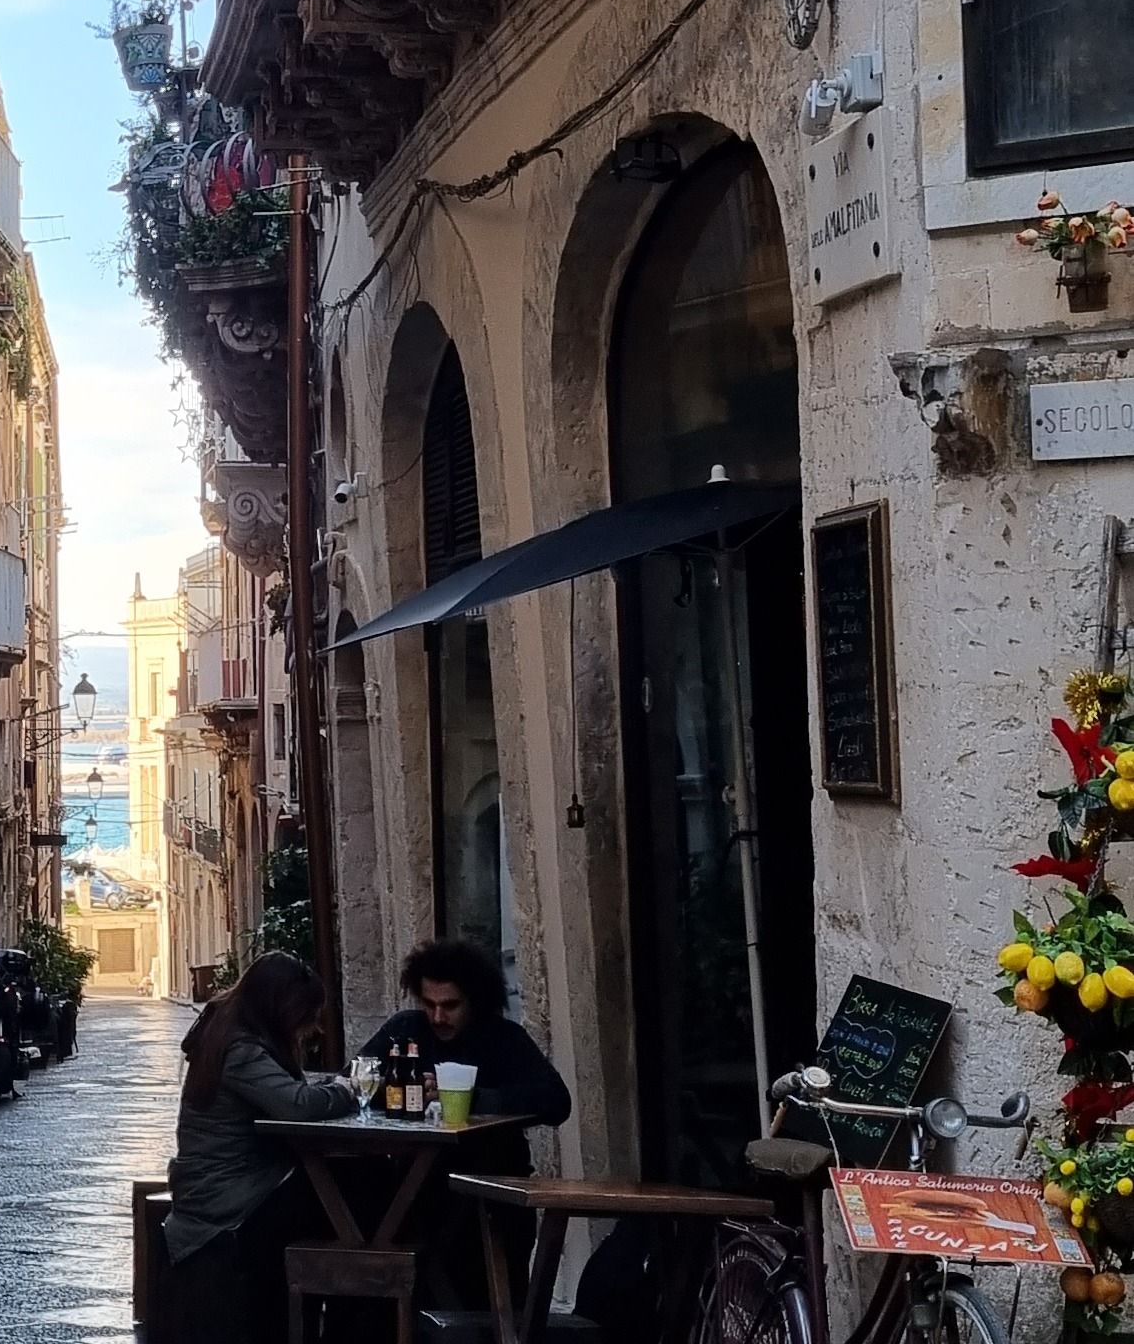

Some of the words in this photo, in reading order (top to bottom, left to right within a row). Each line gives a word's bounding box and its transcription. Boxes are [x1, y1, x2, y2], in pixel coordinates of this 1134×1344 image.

[832, 150, 851, 179] VIA
[1044, 402, 1133, 435] SECOLO
[839, 1170, 912, 1188] L'Antica
[915, 1174, 996, 1194] Salumeria
[887, 1218, 910, 1249] PANE
